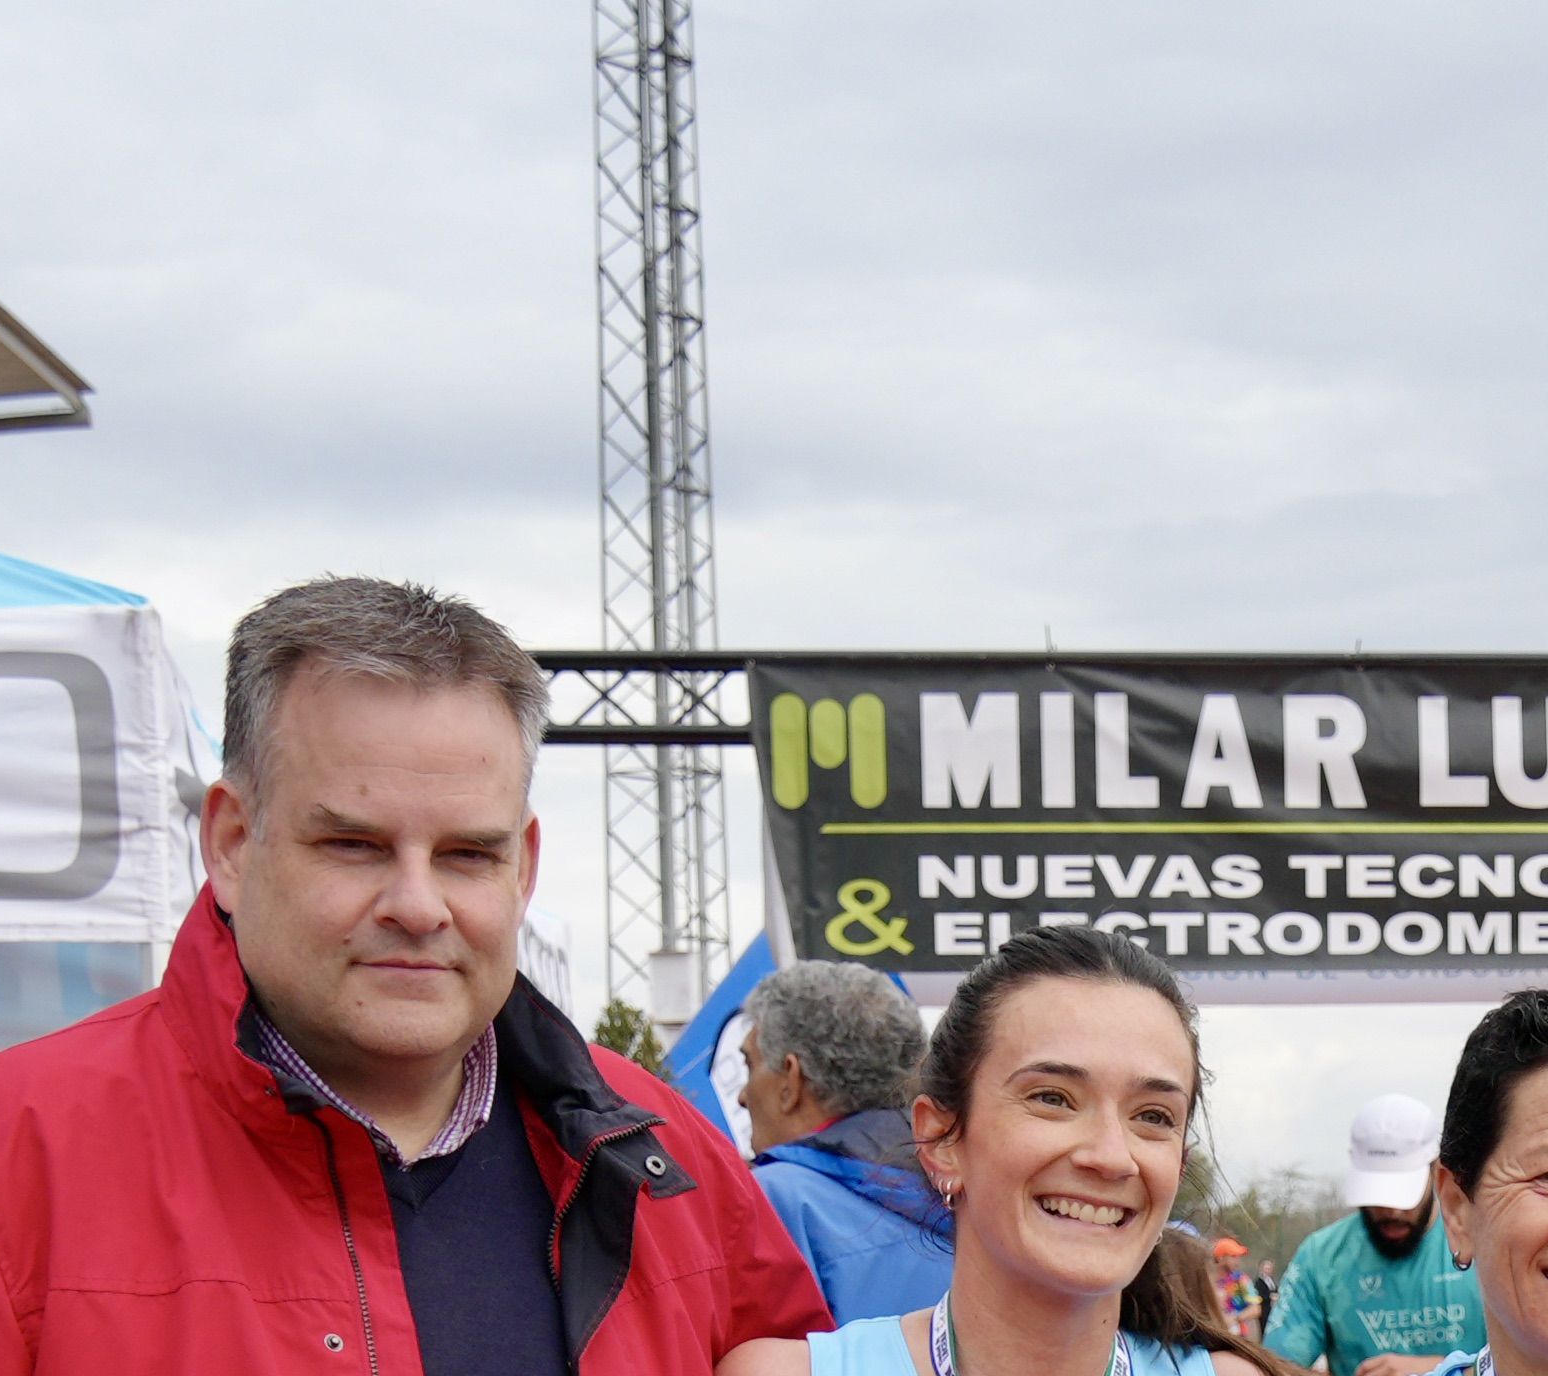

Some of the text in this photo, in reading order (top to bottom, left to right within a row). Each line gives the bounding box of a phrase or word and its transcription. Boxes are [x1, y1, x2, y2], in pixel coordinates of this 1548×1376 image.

[918, 691, 1368, 810] MILAR
[918, 853, 1263, 900] NUEVAS
[824, 878, 915, 956] &
